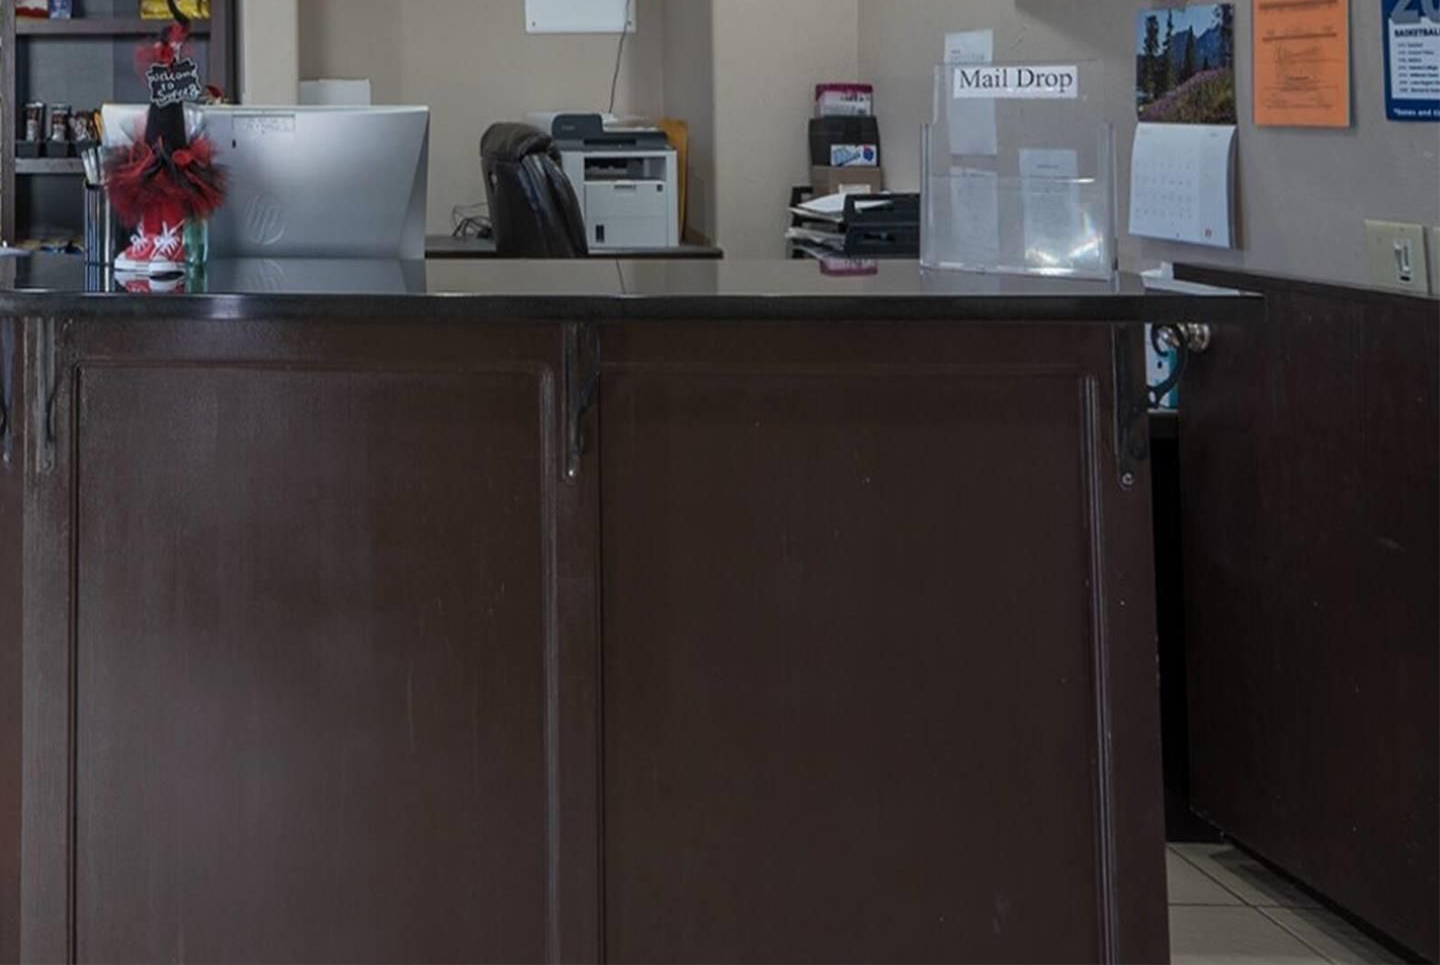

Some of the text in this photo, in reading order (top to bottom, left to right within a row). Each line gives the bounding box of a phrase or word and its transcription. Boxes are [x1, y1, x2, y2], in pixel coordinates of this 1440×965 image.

[1394, 27, 1440, 39] BASKETBAL
[960, 68, 1073, 93] Mail Drop
